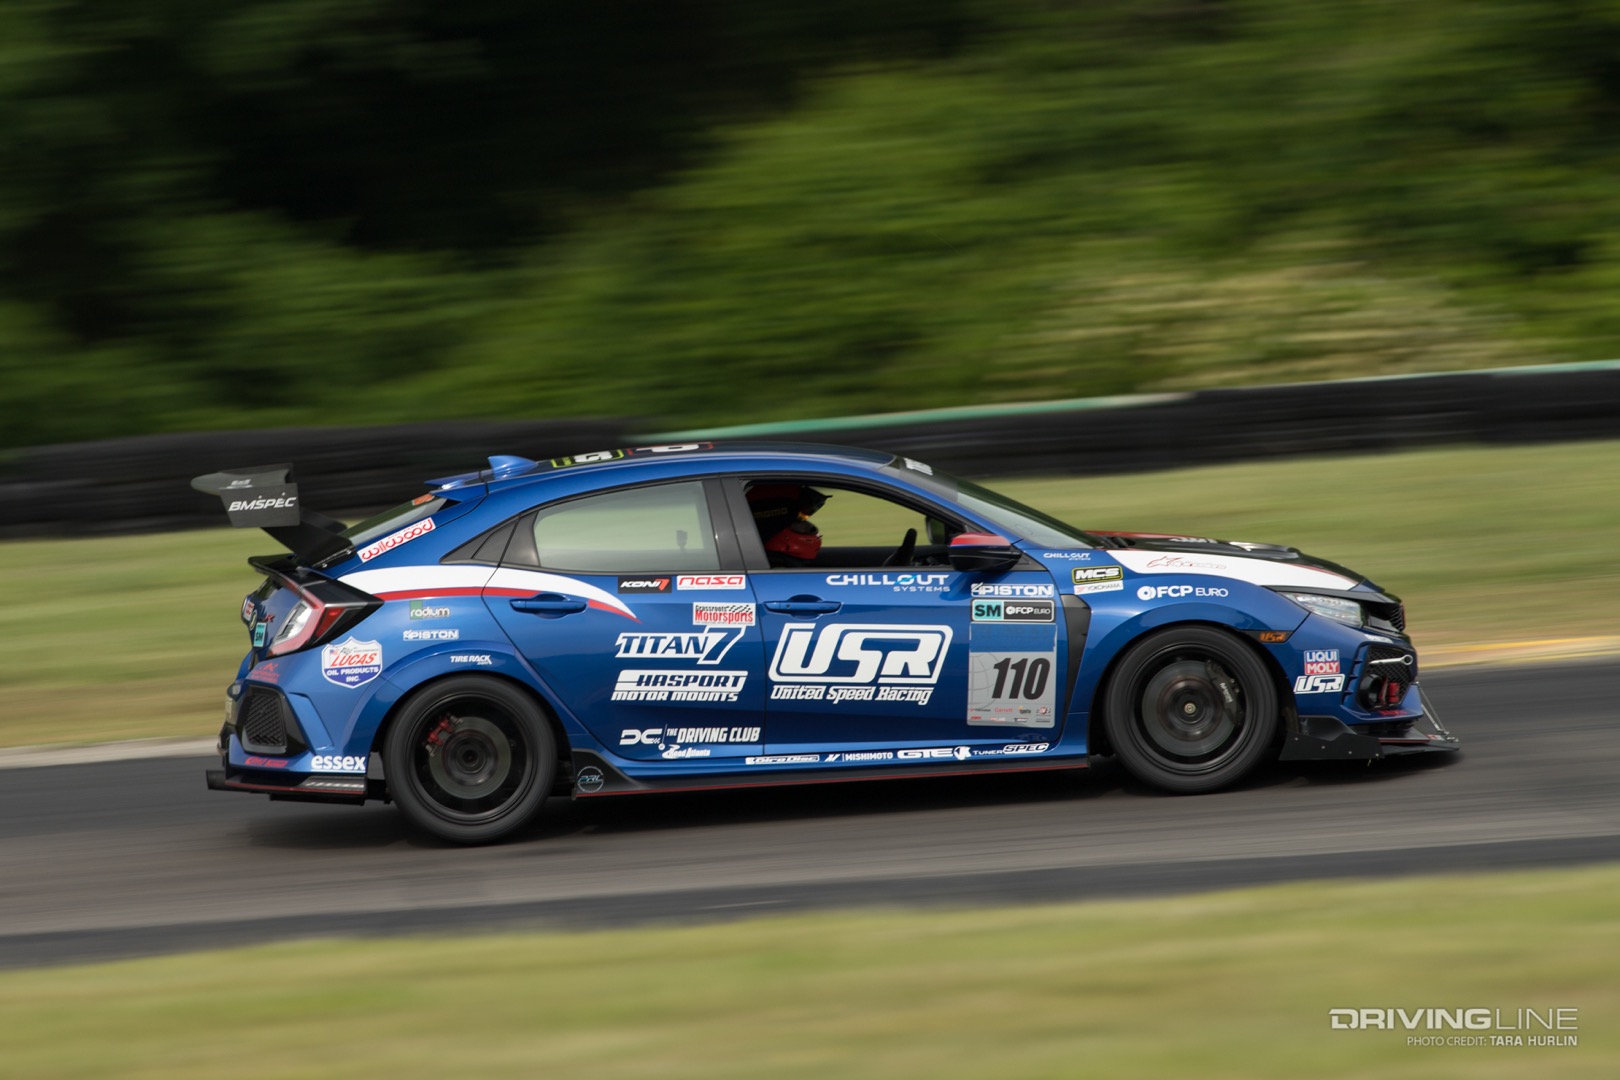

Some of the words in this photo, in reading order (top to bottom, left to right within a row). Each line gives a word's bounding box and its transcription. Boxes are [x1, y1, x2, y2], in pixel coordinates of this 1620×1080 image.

[228, 497, 297, 511] BMSPEC
[361, 518, 433, 560] wilwood
[825, 574, 949, 585] CHILLOUT
[1075, 568, 1119, 580] MCS
[620, 580, 661, 588] KONI
[678, 576, 743, 585] nasa
[1156, 585, 1193, 598] FCP
[1195, 587, 1229, 597] EURO
[410, 606, 450, 617] radium
[695, 604, 728, 612] Grassroots
[974, 604, 1001, 617] SM
[1015, 607, 1033, 615] FCP
[695, 610, 753, 624] Motorsports
[768, 622, 953, 684] USR
[1306, 651, 1337, 662] LIQUI
[331, 653, 377, 666] LUCAS
[340, 667, 379, 675] PRODUCTS
[1306, 662, 1339, 673] MOLY
[626, 672, 747, 688] HASPORT
[991, 657, 1051, 700] 110
[1293, 674, 1345, 694] USR
[611, 691, 668, 701] MOTOR
[670, 692, 738, 702] MOUNTS
[770, 685, 827, 700] United
[827, 686, 876, 704] Speed
[875, 687, 934, 706] Racing
[666, 728, 678, 736] THE
[676, 728, 728, 743] DRIVING
[729, 727, 761, 742] CLUB
[1003, 743, 1049, 754] SPEC
[311, 755, 366, 770] essex
[845, 752, 893, 761] MISHIMOTO
